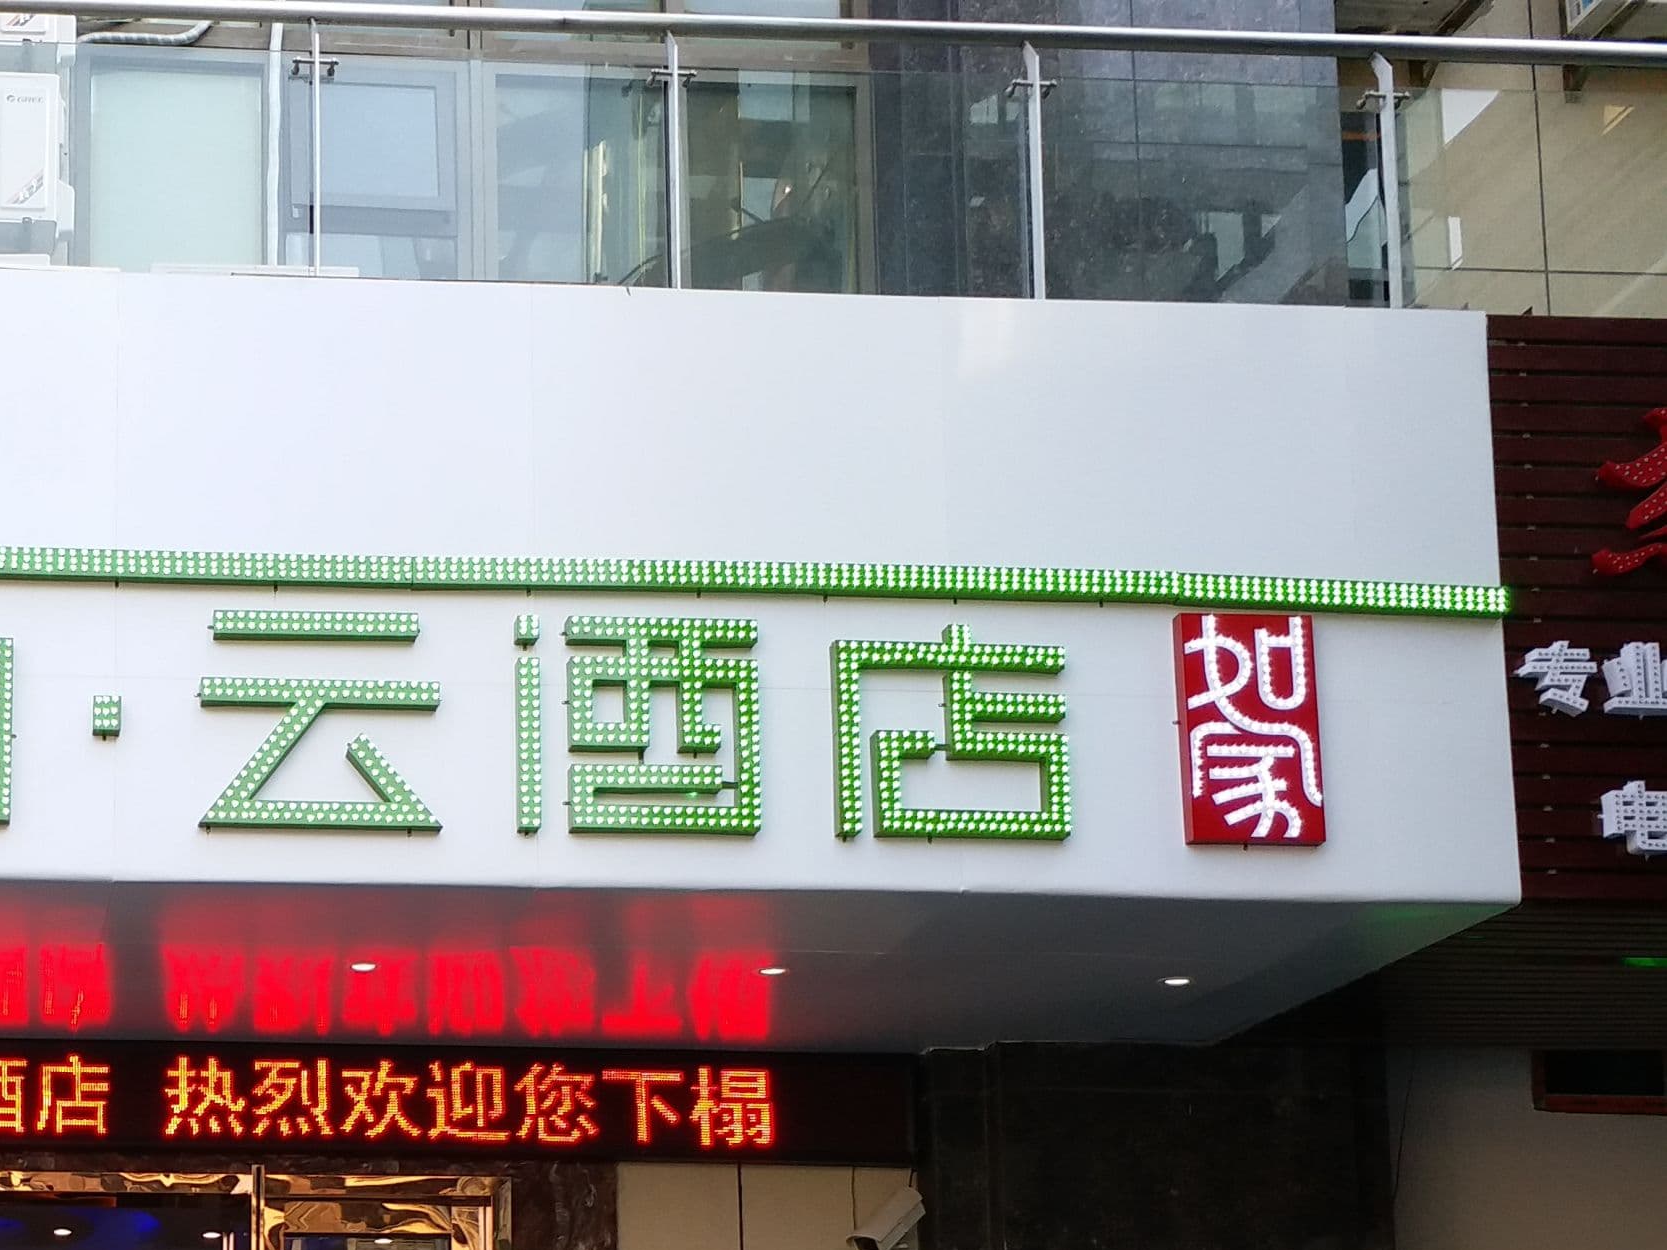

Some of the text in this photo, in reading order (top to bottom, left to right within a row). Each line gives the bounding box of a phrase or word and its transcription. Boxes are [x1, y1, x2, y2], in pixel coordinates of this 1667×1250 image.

[1183, 613, 1323, 838] 如家
[163, 1055, 775, 1148] 热烈欢迎您下榻
